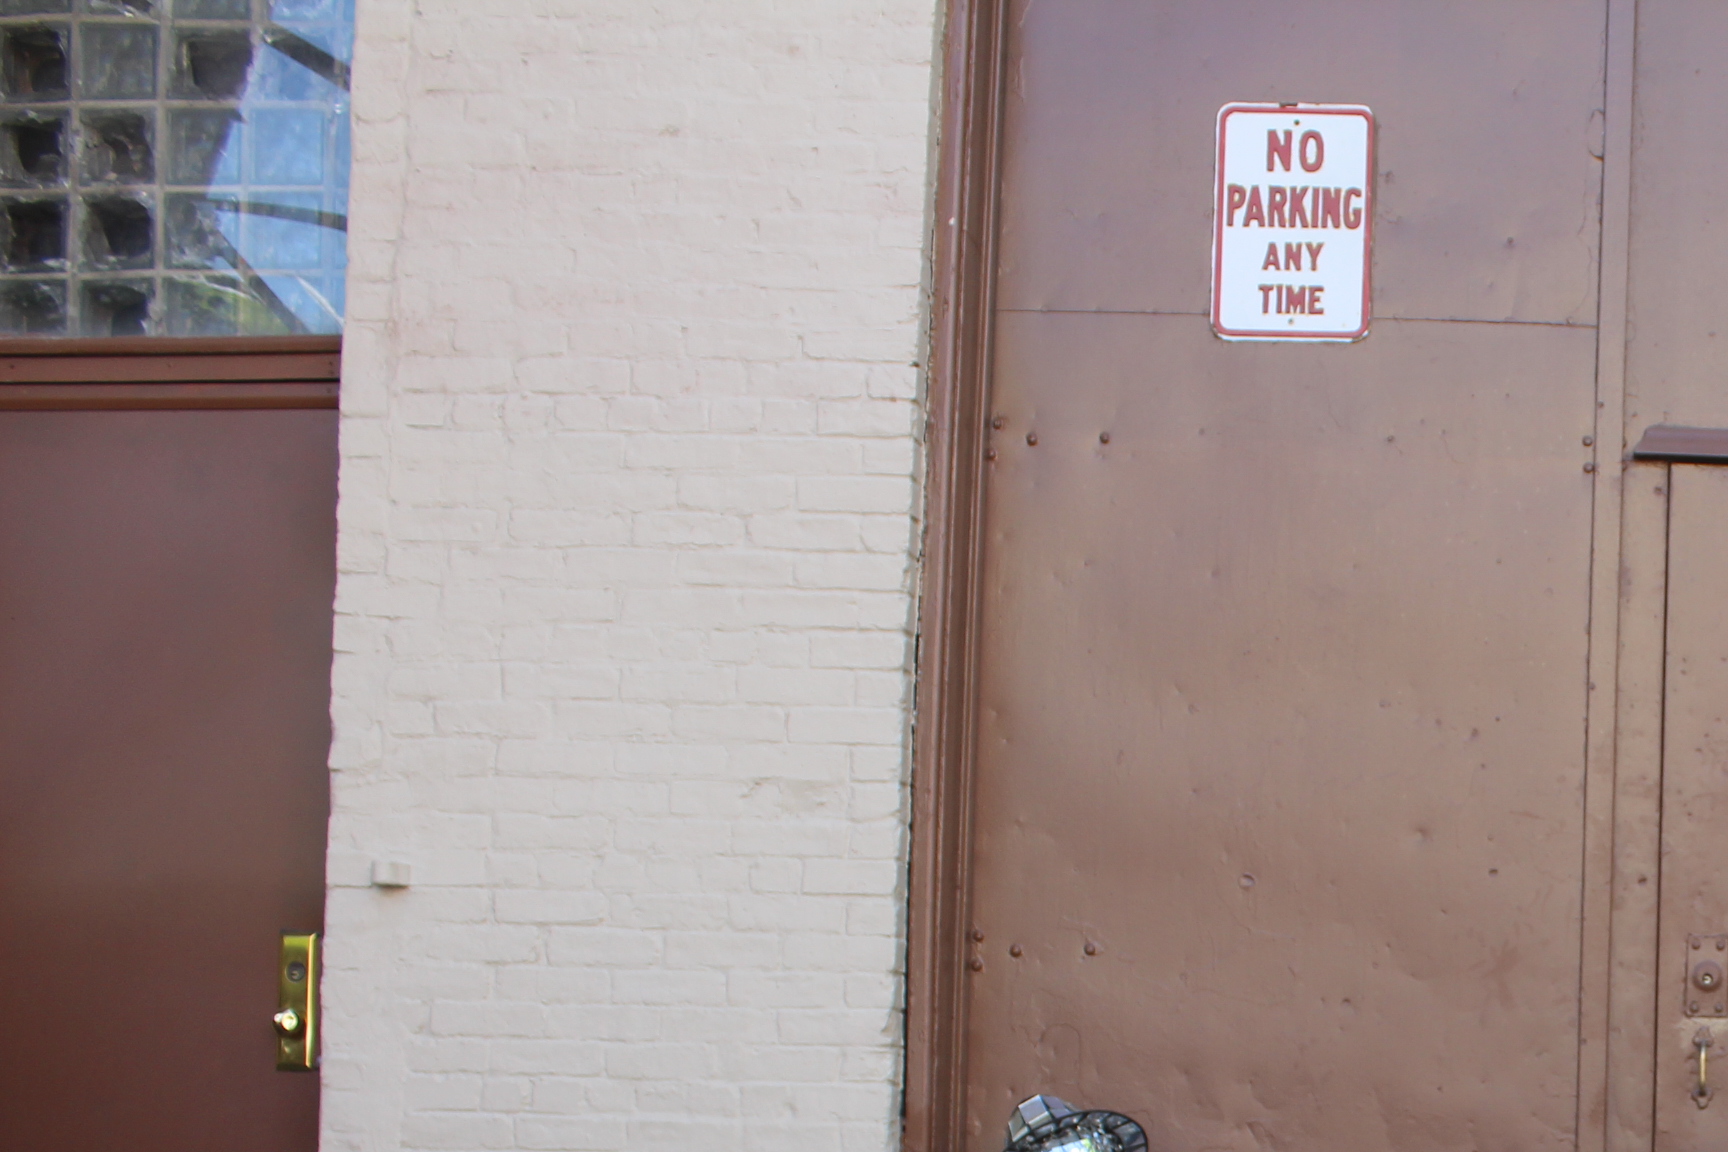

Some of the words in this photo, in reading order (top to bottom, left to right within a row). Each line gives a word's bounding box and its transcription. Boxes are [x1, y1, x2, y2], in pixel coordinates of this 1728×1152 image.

[1266, 129, 1325, 173] NO
[1226, 183, 1363, 230] PARKING
[1261, 241, 1325, 272] ANY
[1258, 284, 1325, 316] TIME
